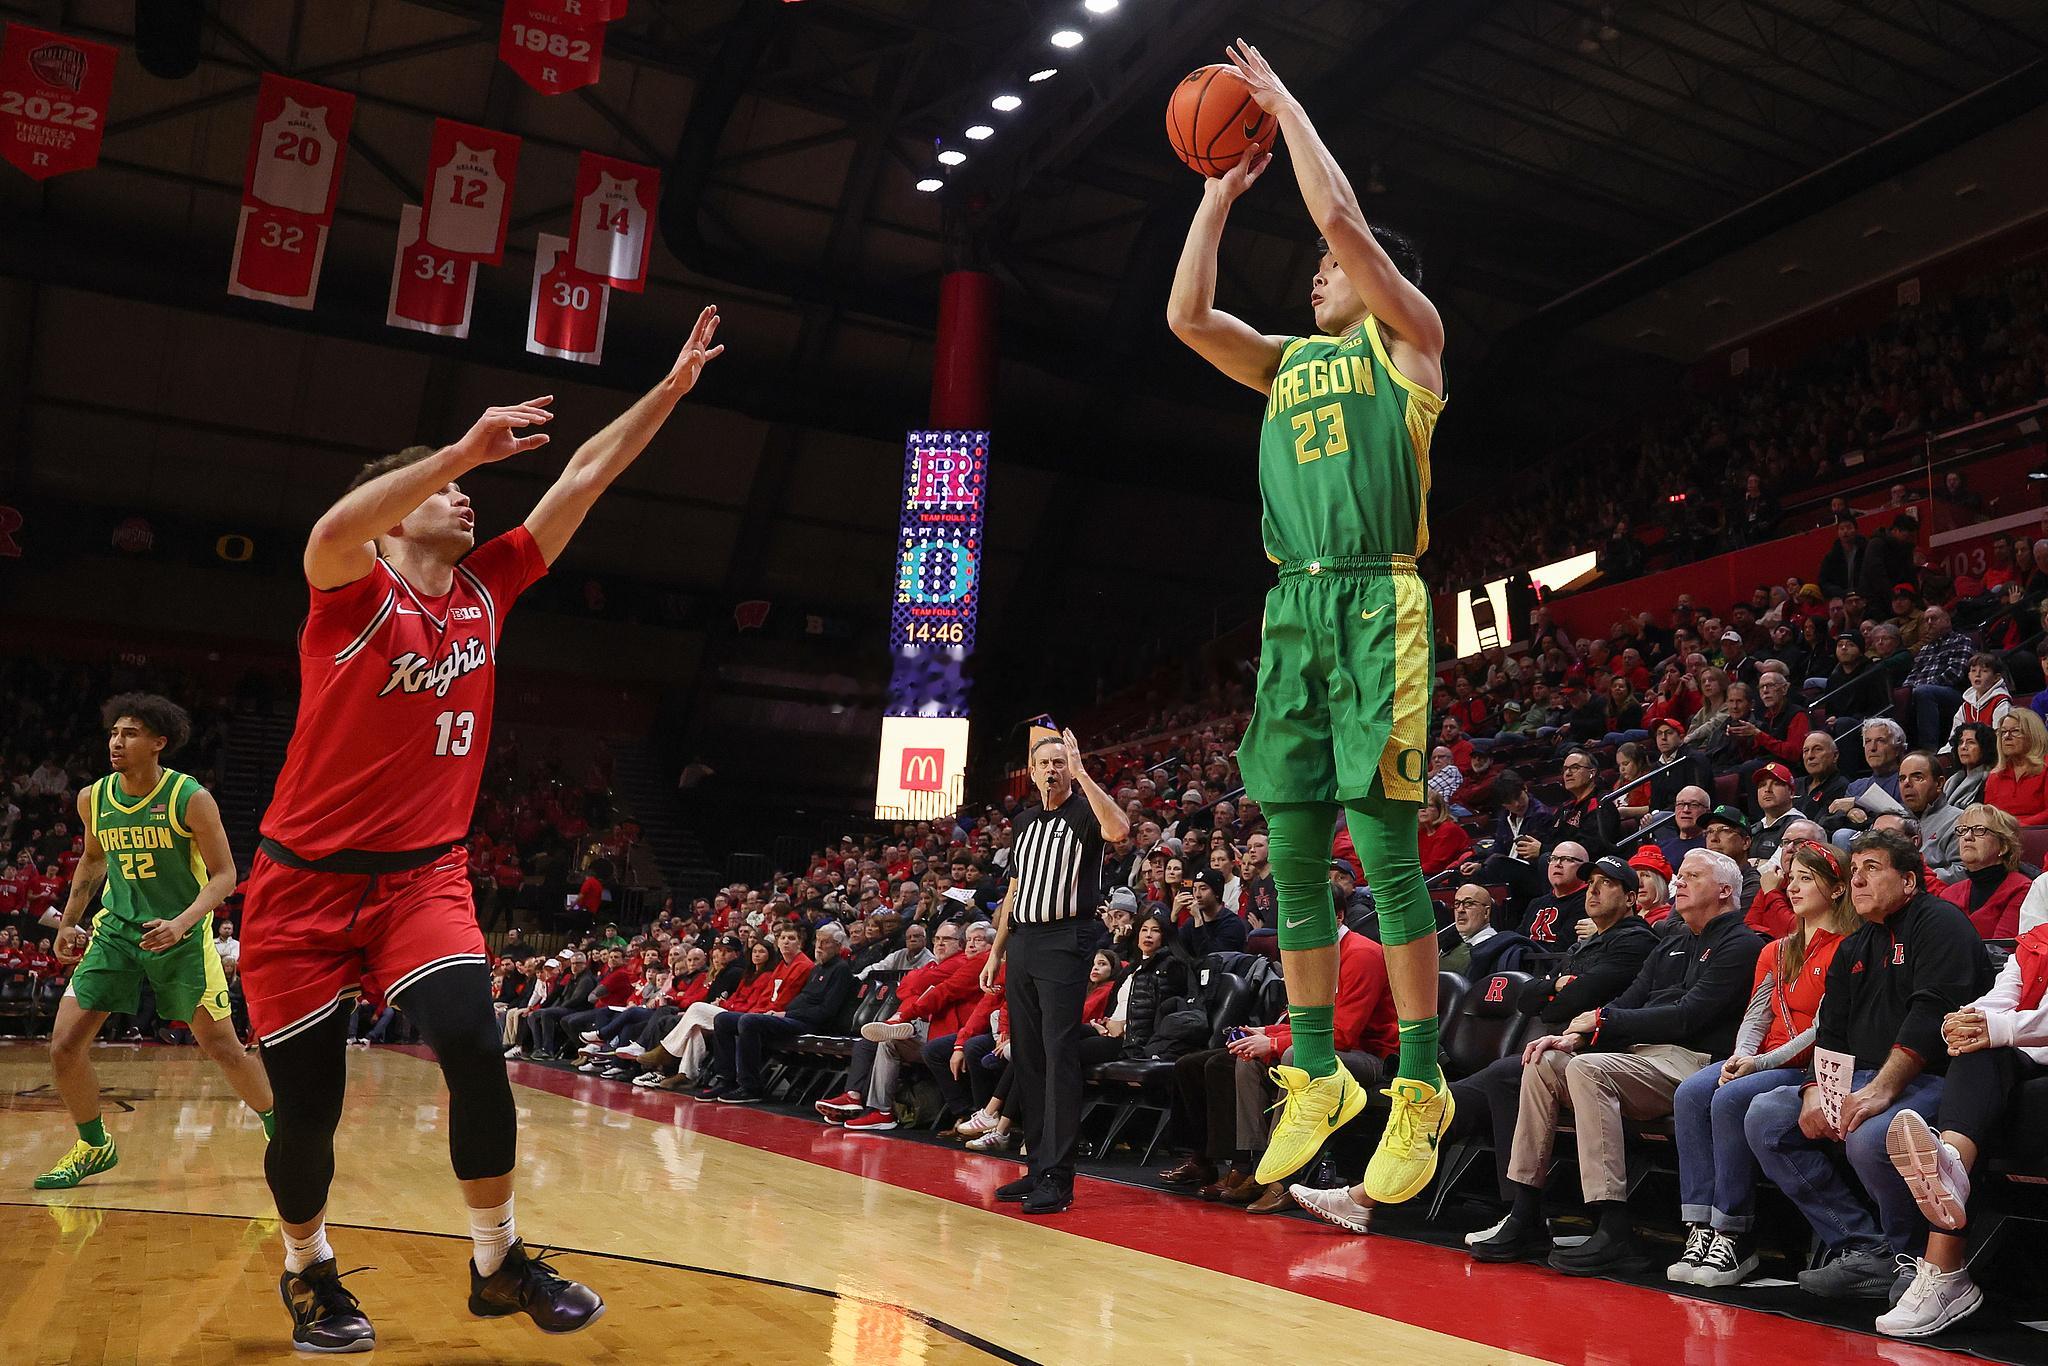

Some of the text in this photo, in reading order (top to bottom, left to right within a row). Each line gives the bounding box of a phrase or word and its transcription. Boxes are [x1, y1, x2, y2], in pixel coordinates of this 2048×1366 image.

[512, 24, 591, 62] 1982
[542, 66, 558, 83] R
[0, 91, 98, 131] 2022
[15, 121, 76, 141] THERESA
[16, 132, 72, 150] GRENTZ
[32, 151, 49, 167] R
[274, 131, 321, 167] 20
[450, 175, 488, 209] 12
[596, 203, 630, 236] 14
[260, 221, 304, 254] 32
[415, 254, 456, 285] 34
[552, 281, 590, 311] 30
[1268, 356, 1376, 423] OREGON
[909, 433, 983, 443] PL PT R A F
[1291, 402, 1350, 465] 23
[902, 527, 977, 537] PL PT R A F
[920, 514, 940, 522] TEAM
[1940, 548, 1986, 578] 103
[911, 608, 931, 616] TEAM
[932, 608, 957, 616] FOULS
[905, 622, 963, 642] 14:46
[379, 637, 486, 697] Knights
[435, 711, 475, 756] 13
[97, 826, 174, 852] OREGON
[119, 852, 157, 880] 22
[1529, 906, 1559, 943] R
[1484, 976, 1509, 1002] R
